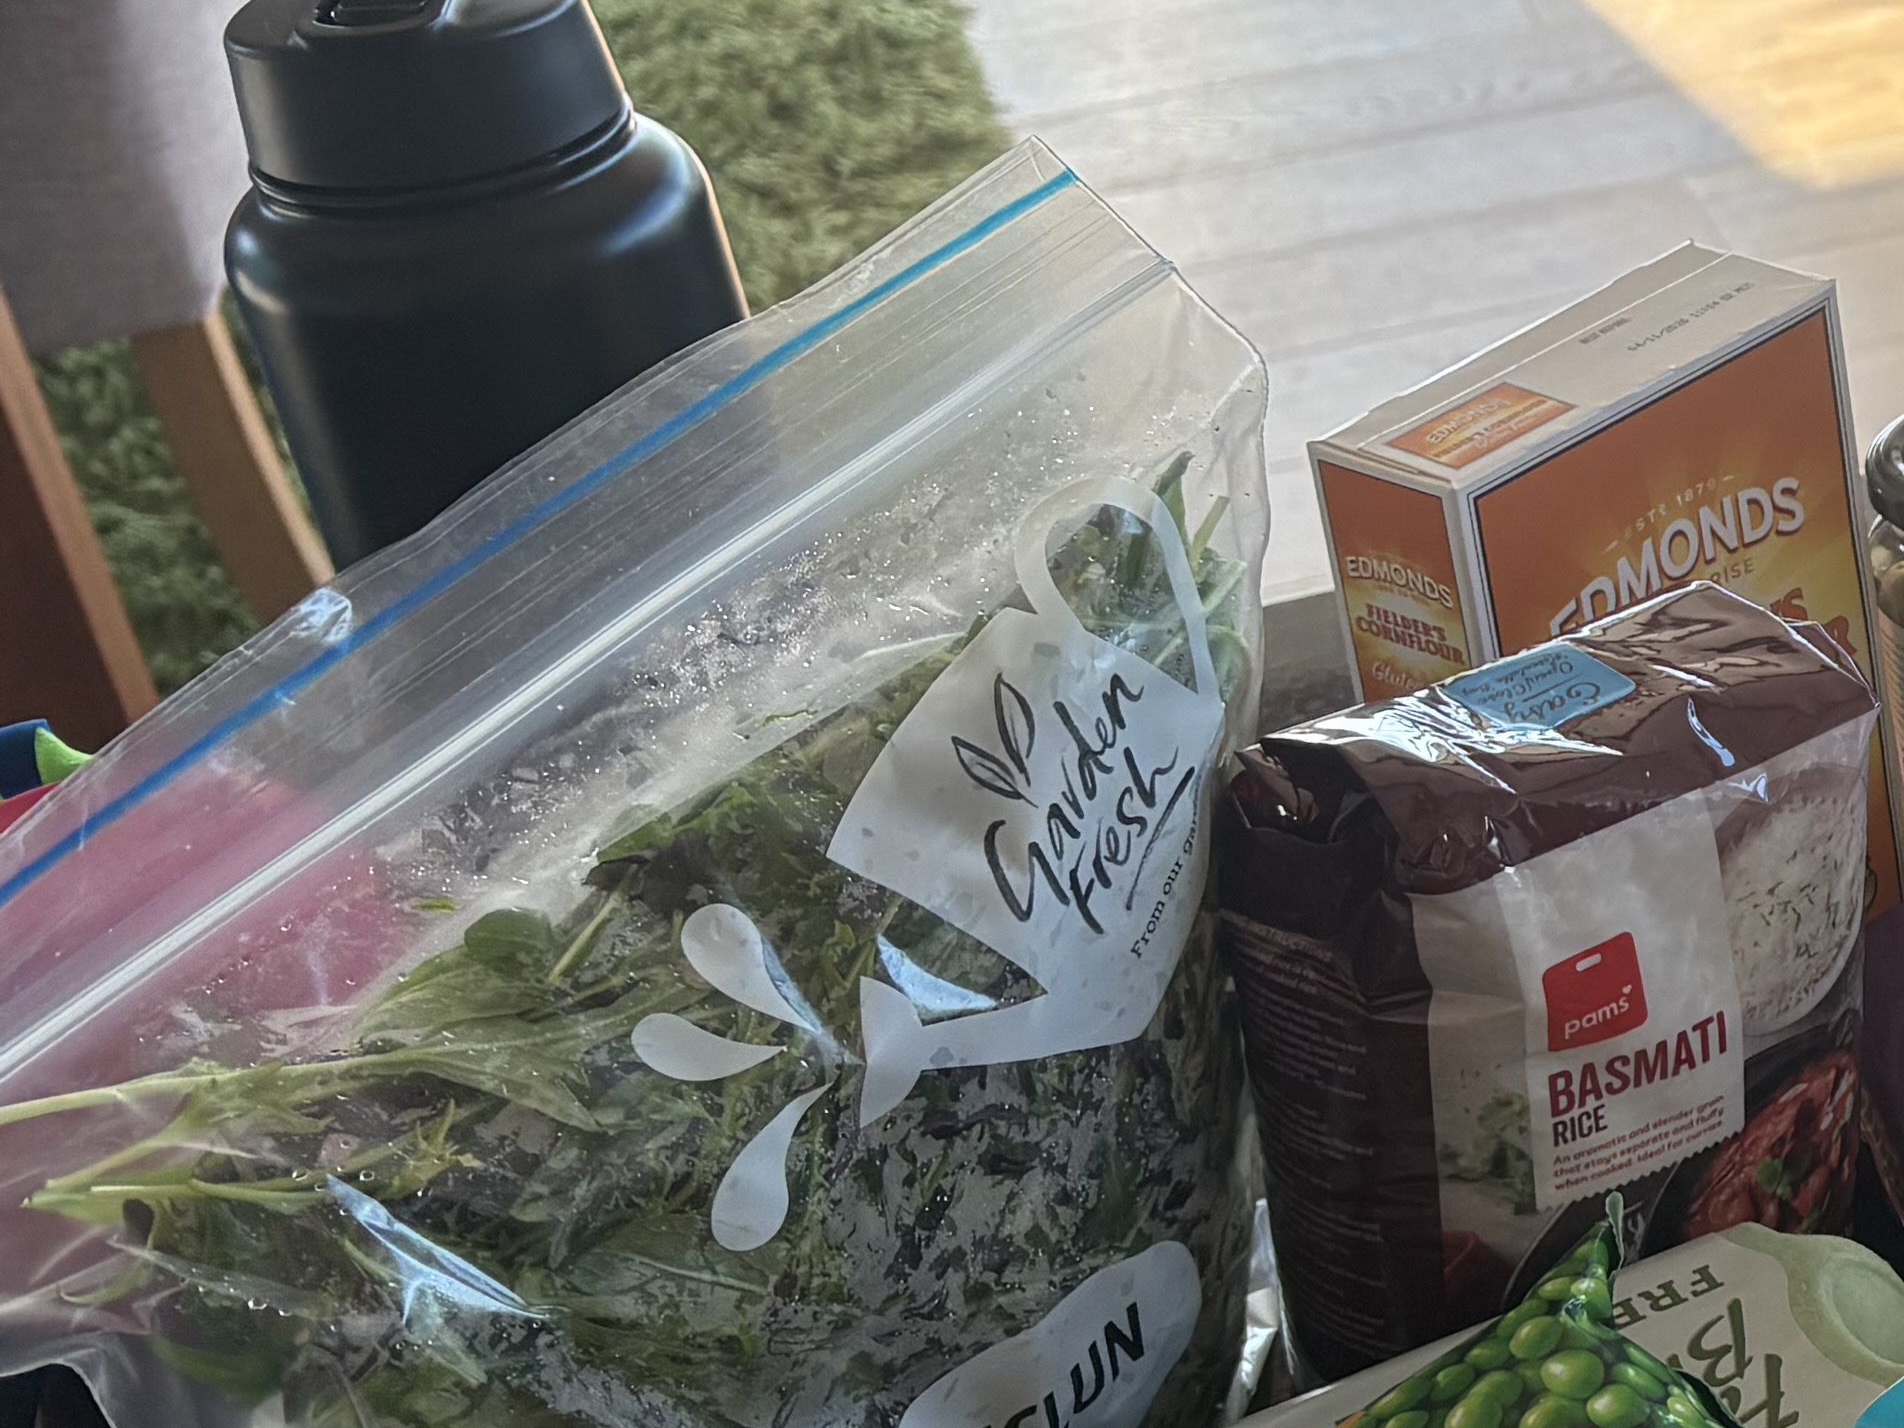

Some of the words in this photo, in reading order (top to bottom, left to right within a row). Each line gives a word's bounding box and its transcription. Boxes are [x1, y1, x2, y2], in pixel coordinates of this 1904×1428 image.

[1346, 556, 1455, 609] EDMONDS
[1356, 616, 1466, 665] CORNFLOUR
[1504, 682, 1602, 723] Easy
[982, 672, 1145, 923] Garden
[1067, 746, 1177, 934] Fresh
[1130, 900, 1166, 959] From
[1162, 856, 1184, 896] our
[1563, 996, 1630, 1040] pams
[1548, 1010, 1728, 1119] BASMATI
[1553, 1104, 1608, 1148] RICE
